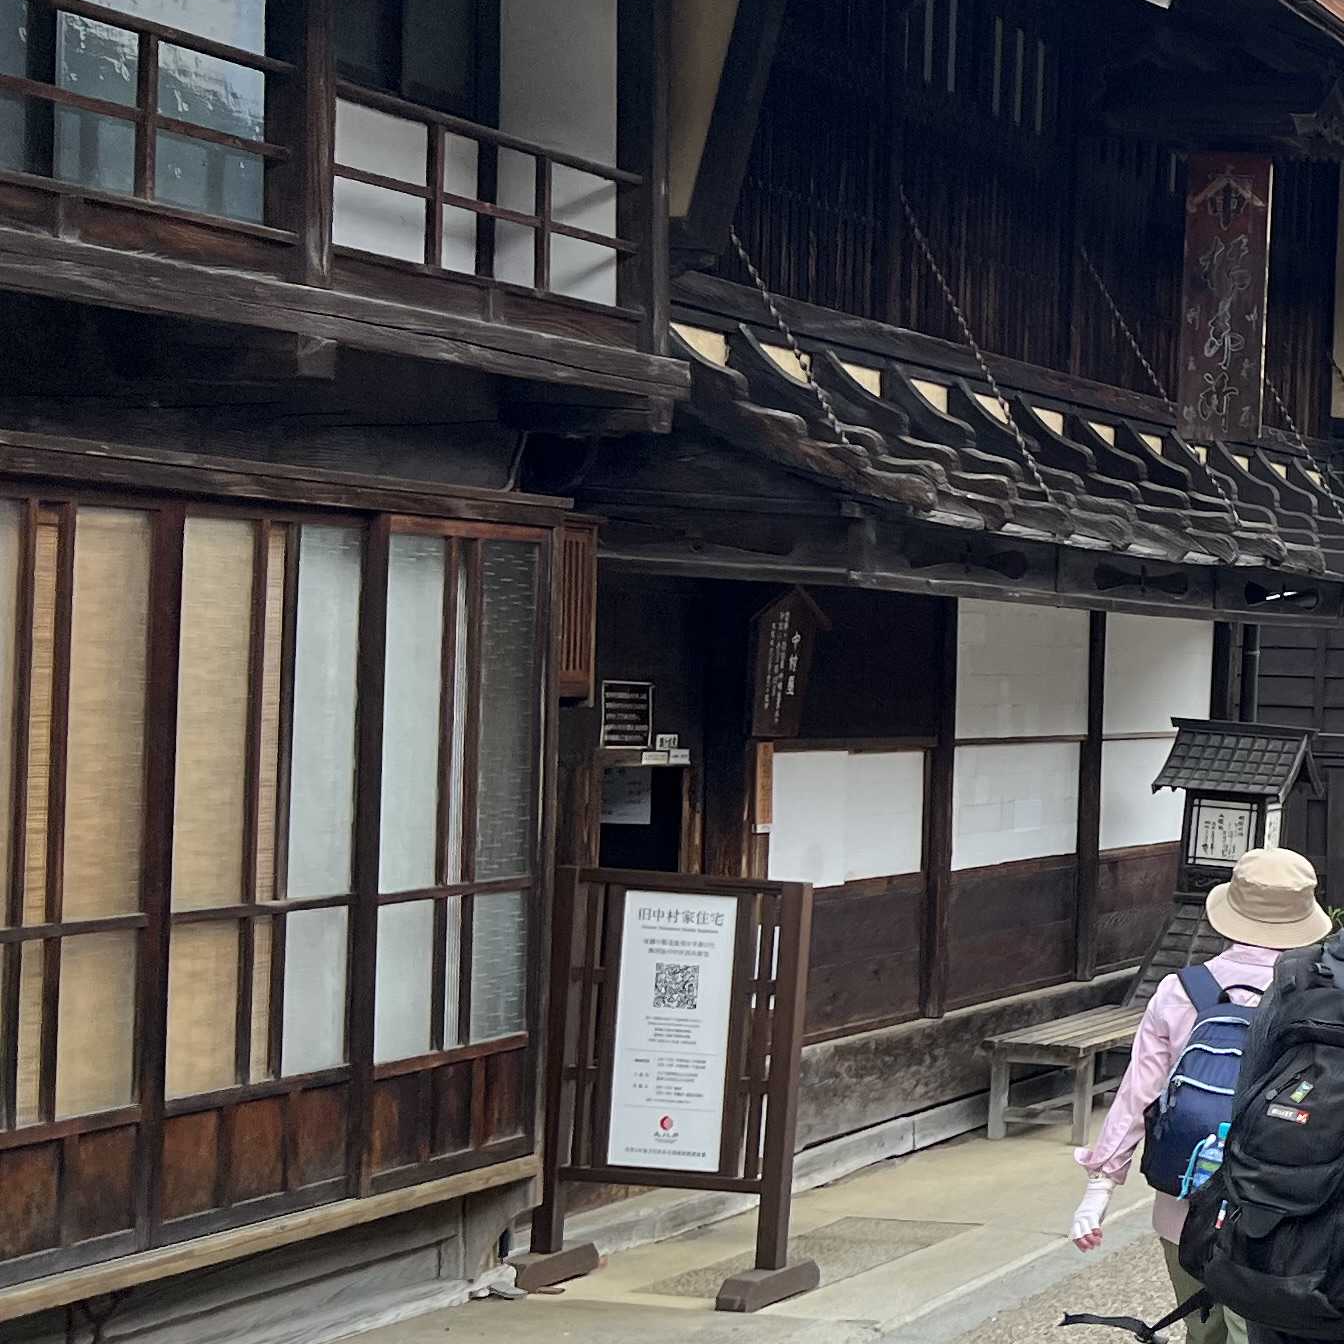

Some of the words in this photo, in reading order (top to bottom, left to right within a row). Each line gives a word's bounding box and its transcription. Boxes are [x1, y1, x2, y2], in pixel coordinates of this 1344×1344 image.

[638, 907, 725, 926] 旧中村家住宅
